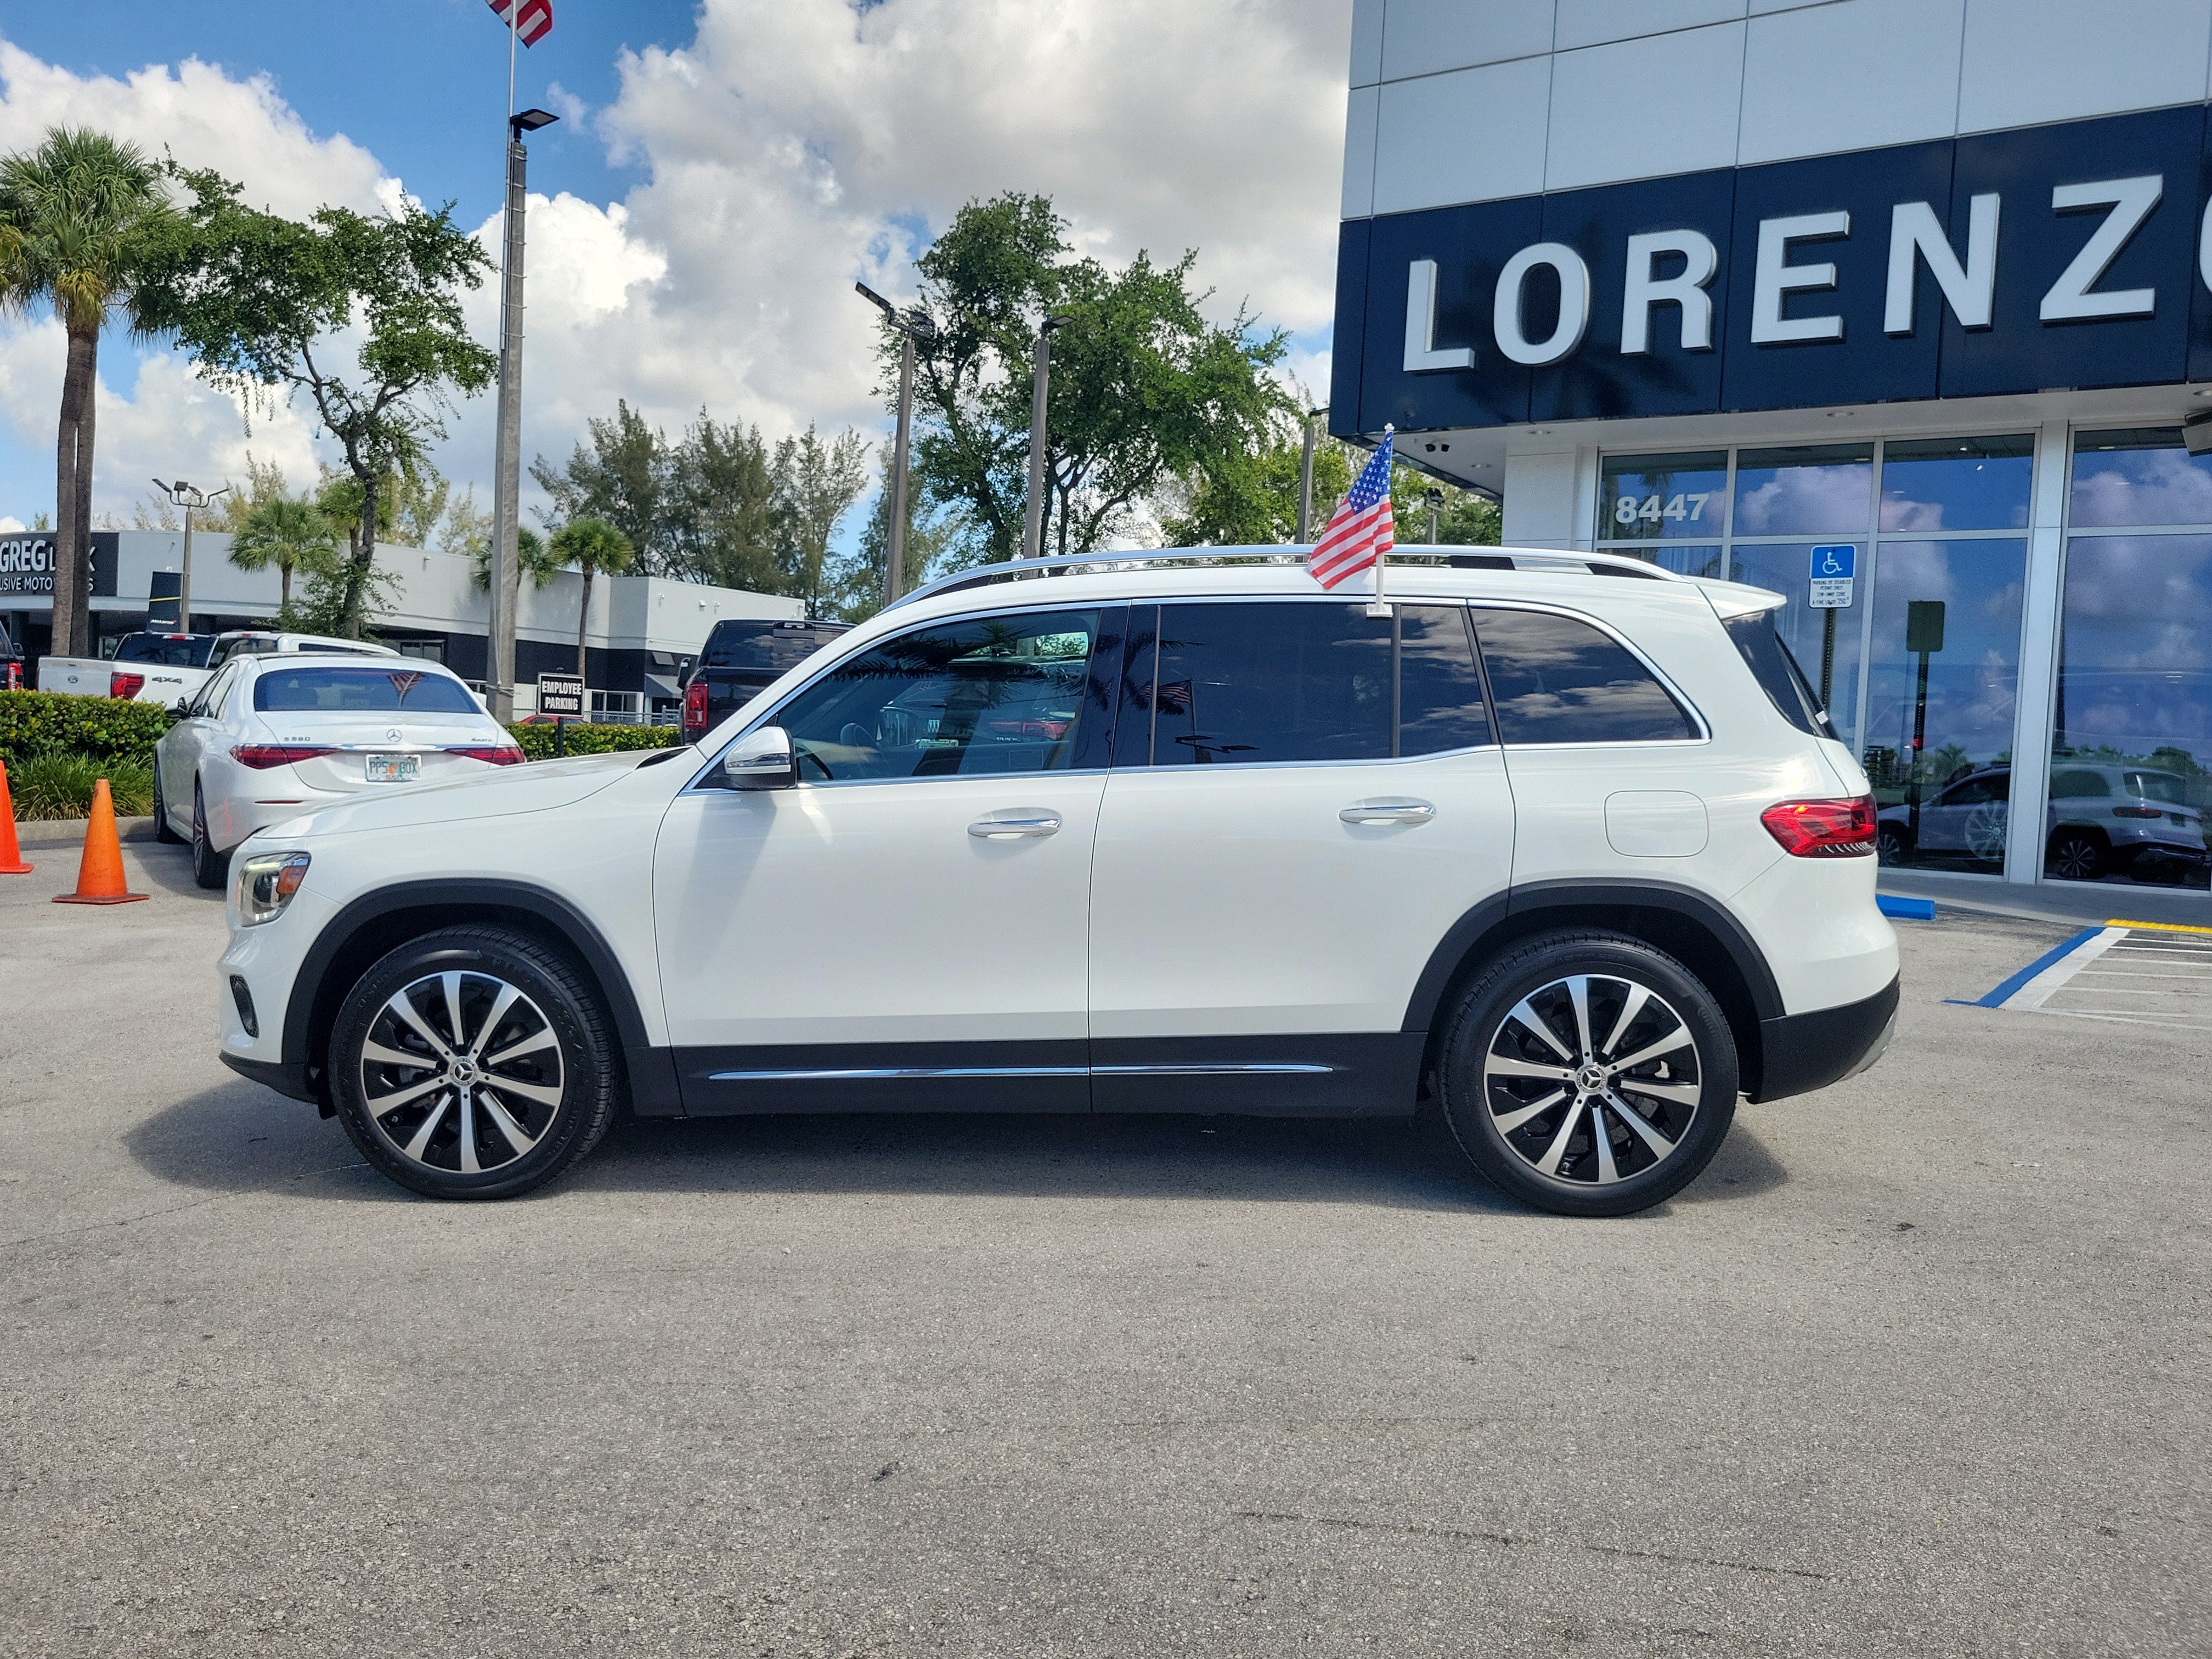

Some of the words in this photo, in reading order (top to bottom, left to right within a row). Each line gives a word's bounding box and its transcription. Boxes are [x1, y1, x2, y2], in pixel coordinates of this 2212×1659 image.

[1615, 494, 1709, 523] 8447
[0, 540, 46, 572] GREG
[541, 681, 582, 695] EMPLOYEE
[544, 696, 578, 710] PARKING
